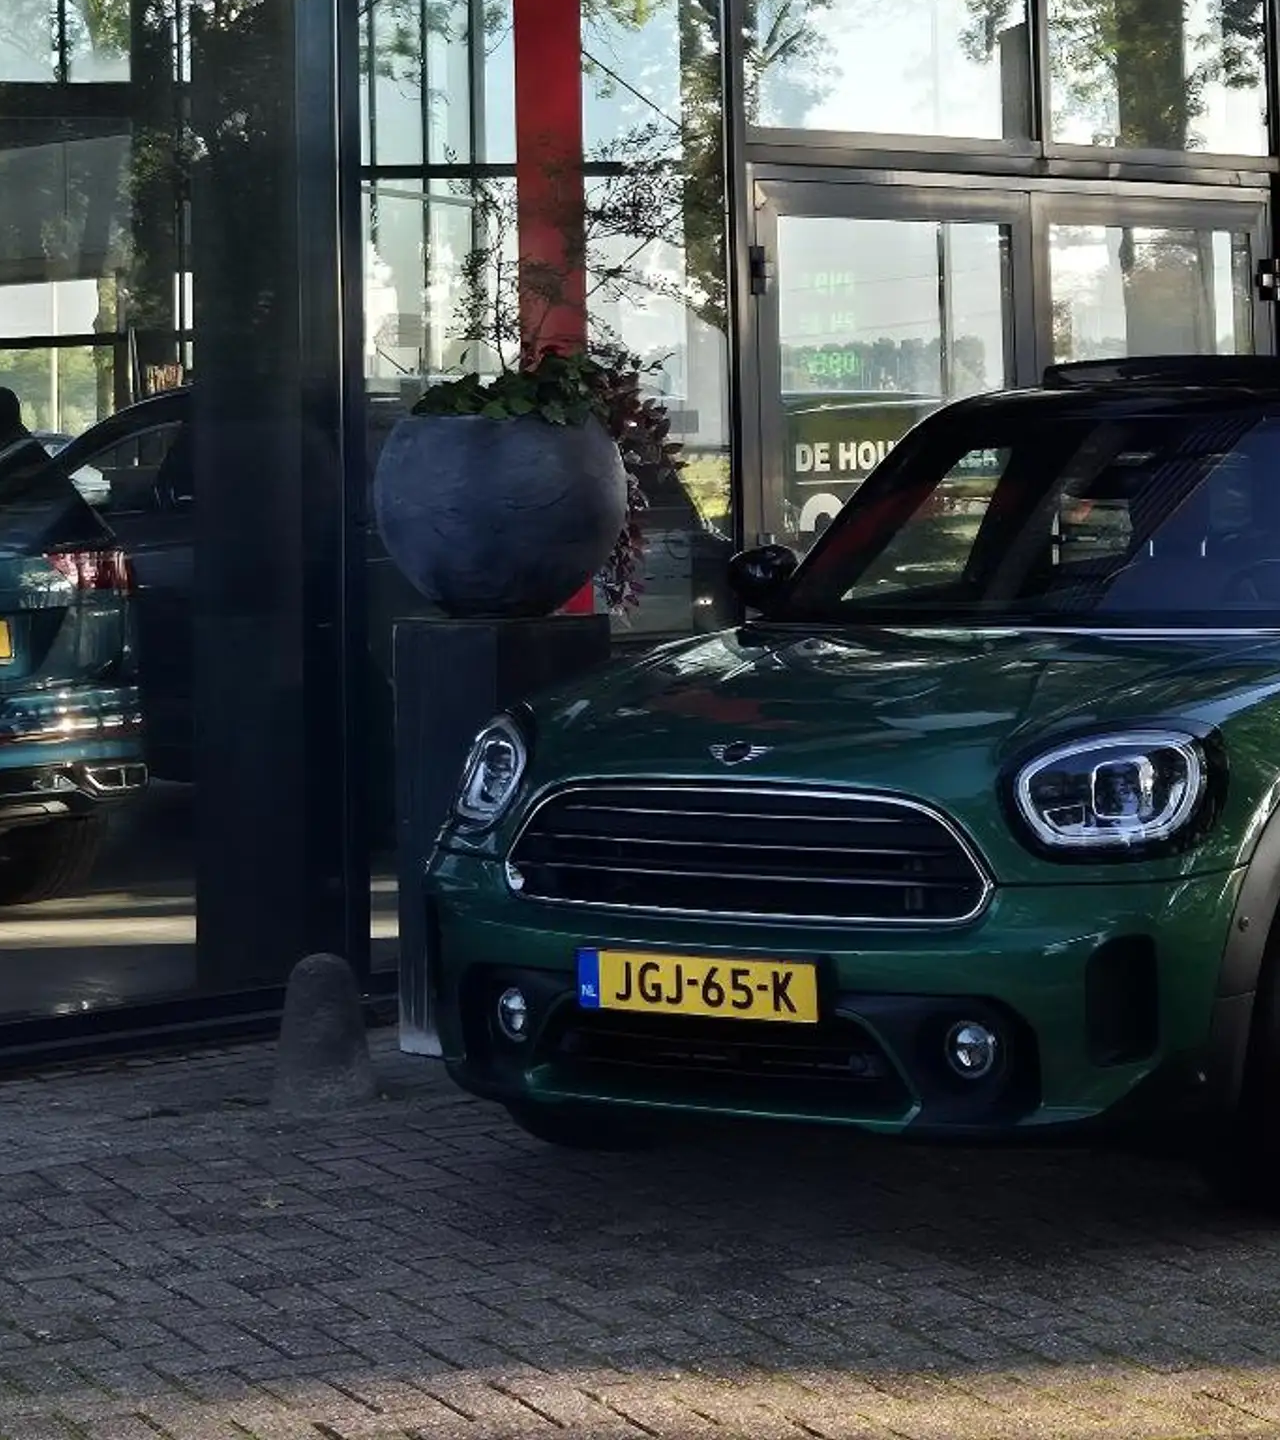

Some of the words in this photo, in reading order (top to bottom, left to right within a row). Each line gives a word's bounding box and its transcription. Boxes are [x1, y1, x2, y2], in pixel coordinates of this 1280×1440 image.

[795, 442, 831, 472] DE
[580, 983, 597, 997] NL
[615, 961, 797, 1013] JGJ-65-K
